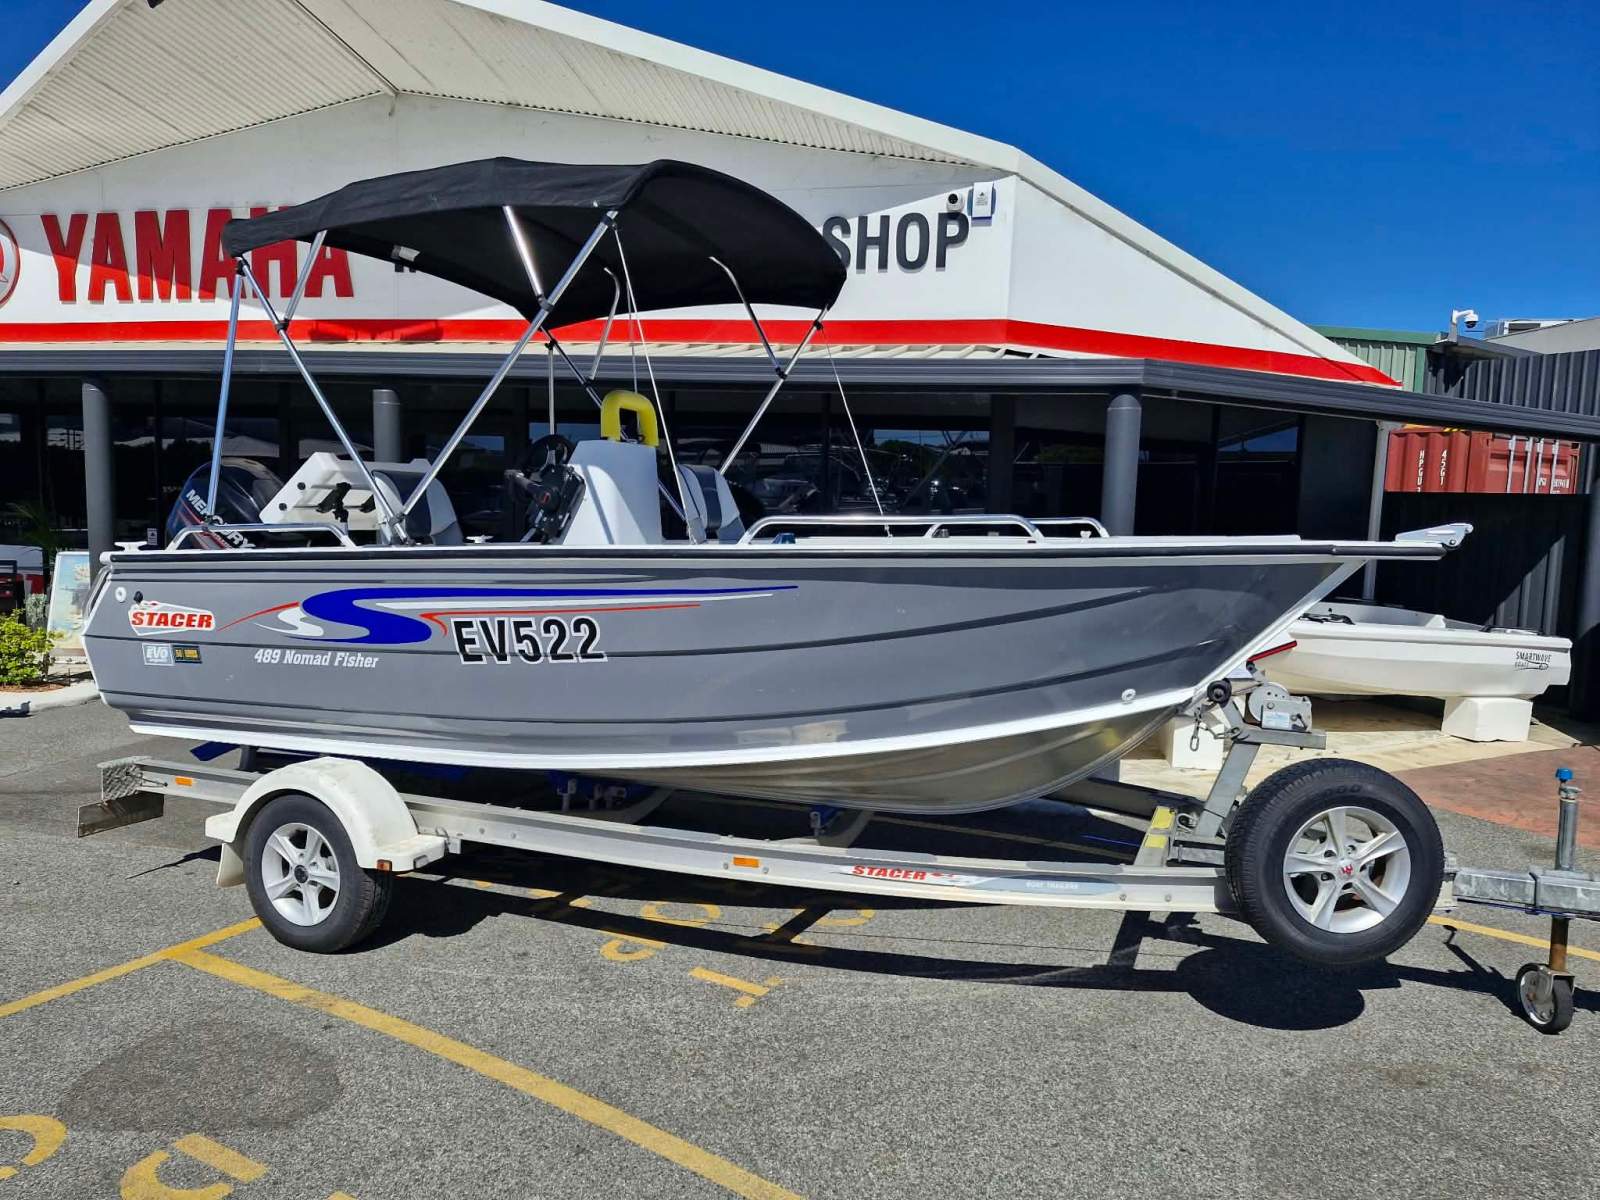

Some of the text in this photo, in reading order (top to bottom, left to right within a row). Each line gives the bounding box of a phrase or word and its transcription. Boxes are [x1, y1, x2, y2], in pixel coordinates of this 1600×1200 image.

[40, 205, 354, 303] YAMAHA
[823, 212, 969, 270] SHOP
[131, 611, 213, 628] STACER
[452, 617, 607, 664] EV522
[254, 649, 379, 668] 489 Nomad Fisher
[852, 865, 926, 880] STACER
